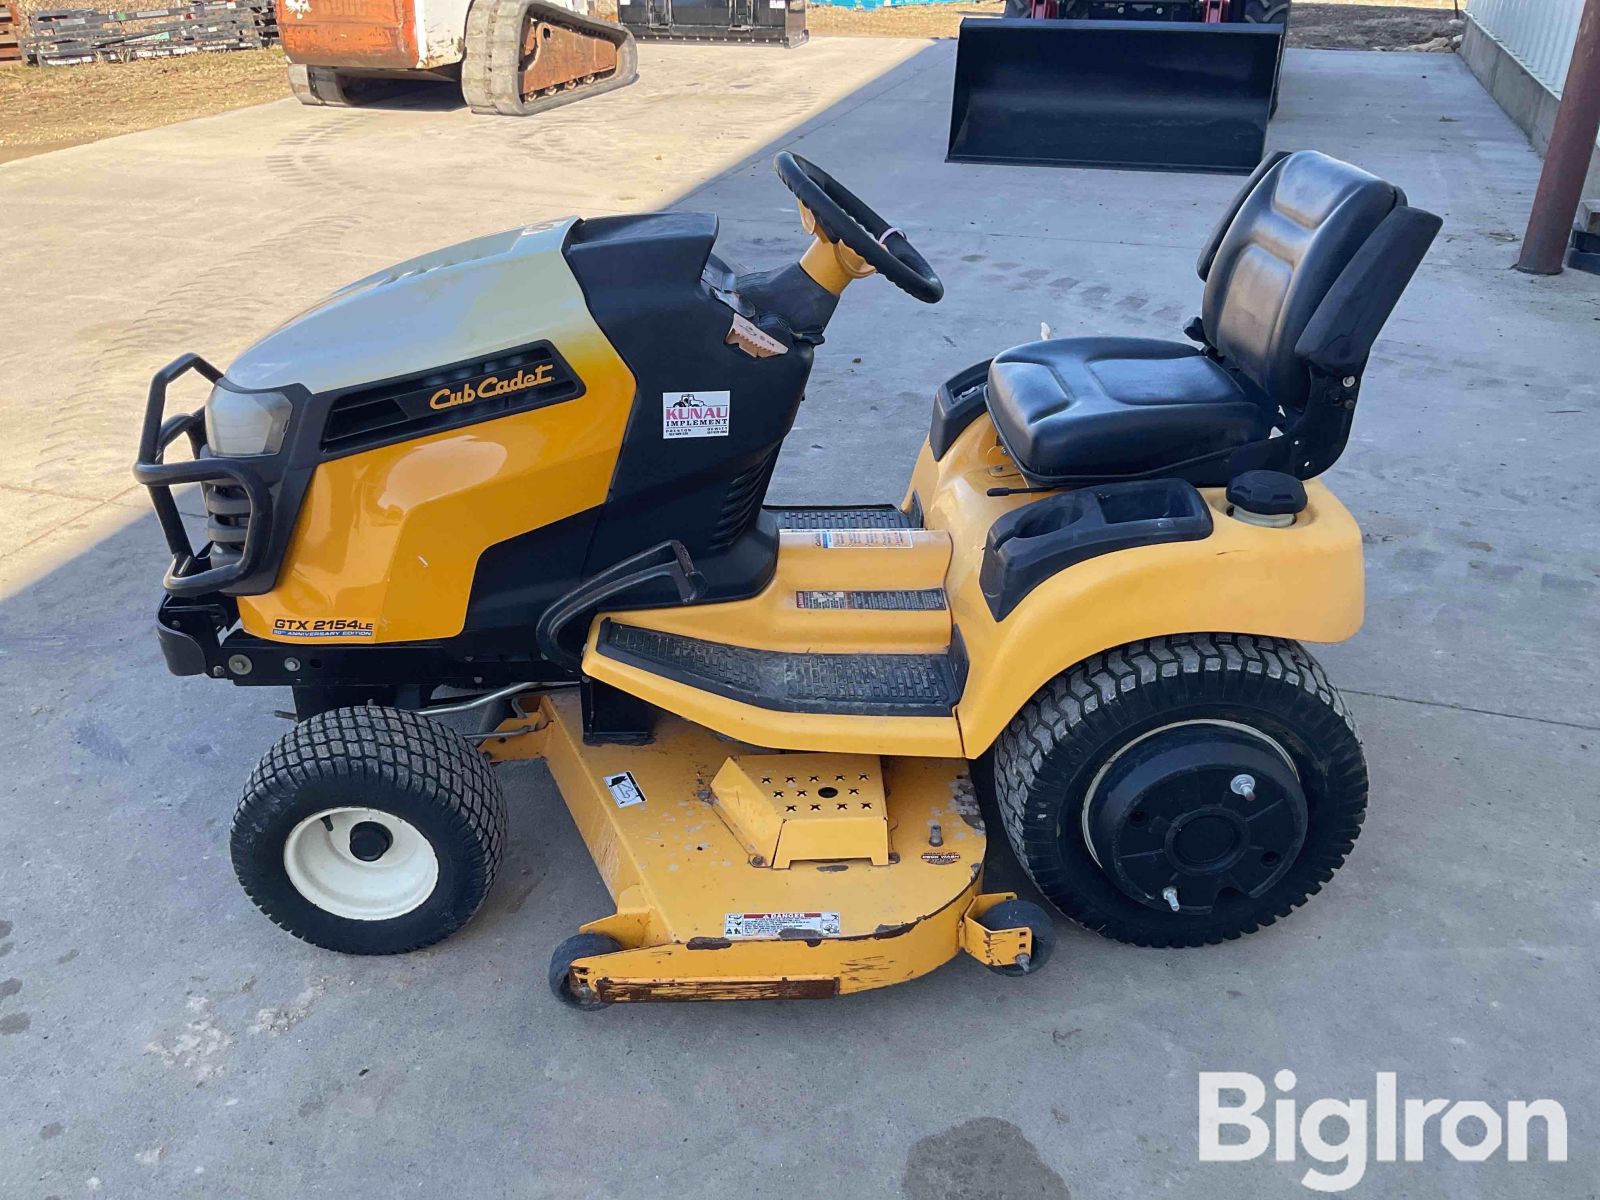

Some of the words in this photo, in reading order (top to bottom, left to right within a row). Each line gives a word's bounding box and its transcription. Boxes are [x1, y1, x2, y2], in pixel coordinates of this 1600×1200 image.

[429, 383, 476, 410] Cub
[477, 364, 554, 398] Cadet
[665, 407, 728, 420] KUNAU
[665, 419, 728, 427] IMPLEMENT
[274, 618, 310, 630] GTX
[313, 619, 374, 630] 2154LE
